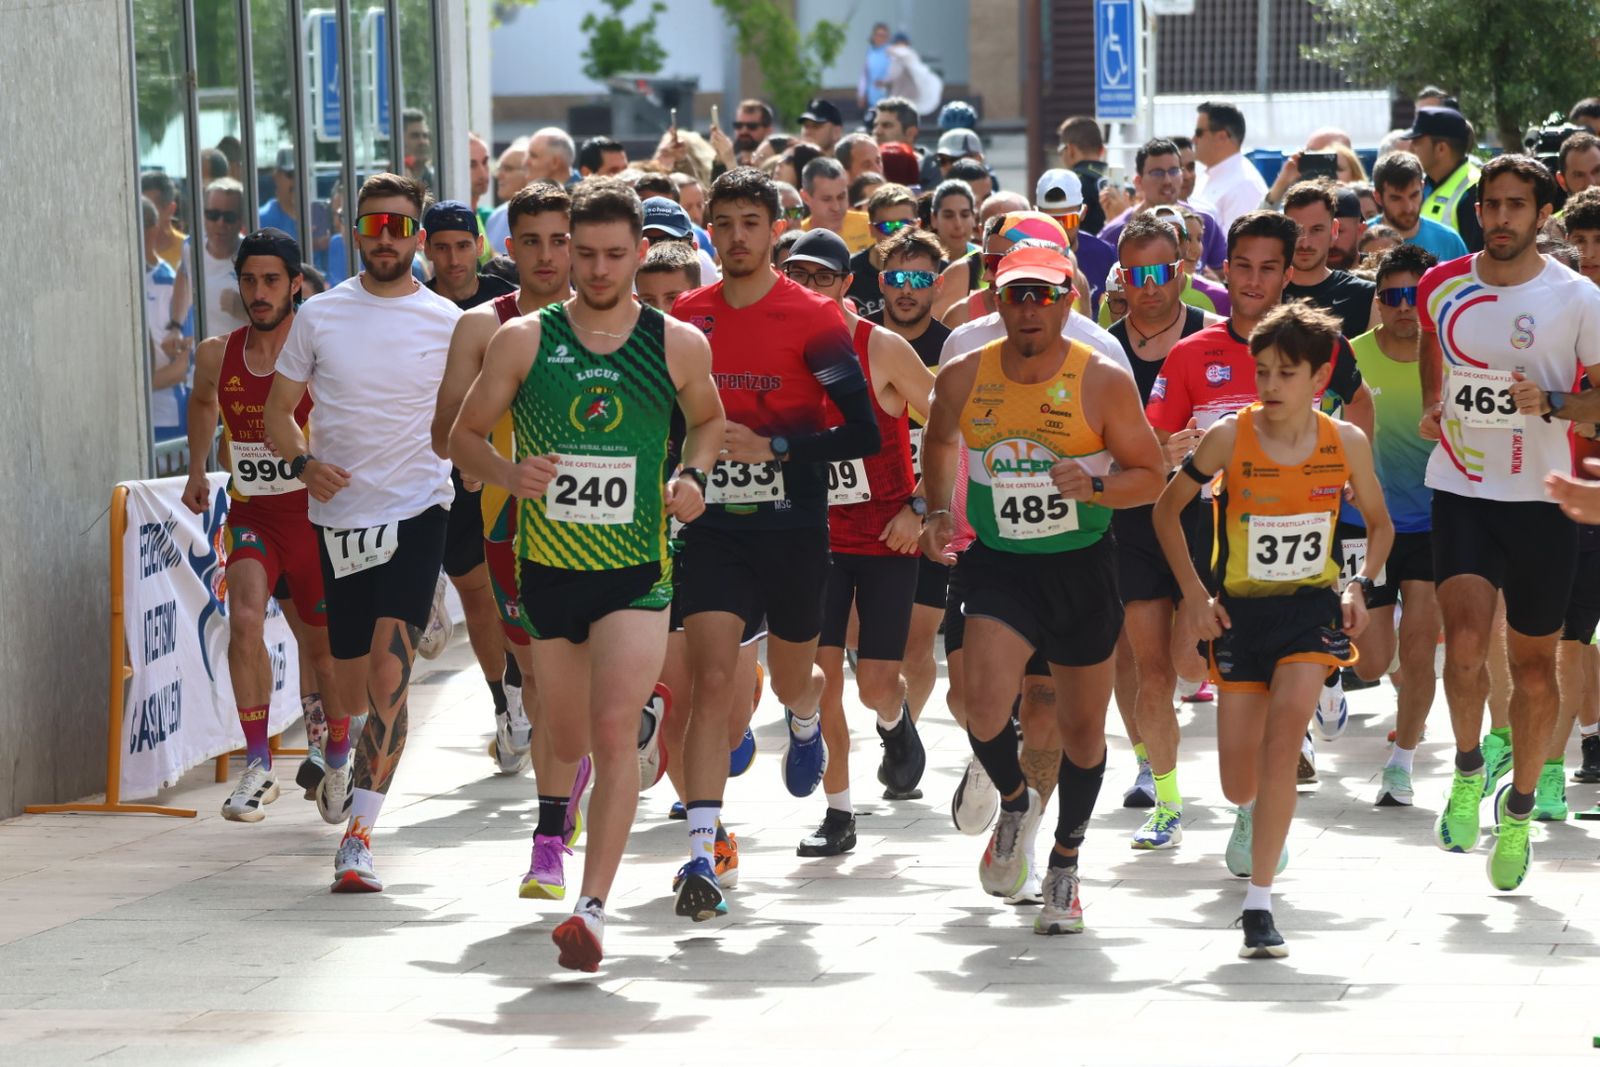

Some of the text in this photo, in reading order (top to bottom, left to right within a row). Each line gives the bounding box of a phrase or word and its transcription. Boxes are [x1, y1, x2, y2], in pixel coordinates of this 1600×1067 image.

[576, 368, 620, 381] LUCUS
[1473, 373, 1499, 381] CASTILLA
[1455, 384, 1518, 415] 463
[238, 459, 299, 482] 990
[575, 461, 607, 469] CASTILLA
[712, 460, 775, 487] 533
[827, 460, 858, 490] 09
[555, 474, 627, 508] 240
[774, 499, 792, 509] MSC
[1000, 494, 1069, 524] 485
[1266, 520, 1276, 528] DE
[1276, 519, 1306, 528] CASTILLA
[334, 524, 388, 558] 777
[1256, 531, 1322, 565] 373
[144, 600, 177, 665] ATLETISMO
